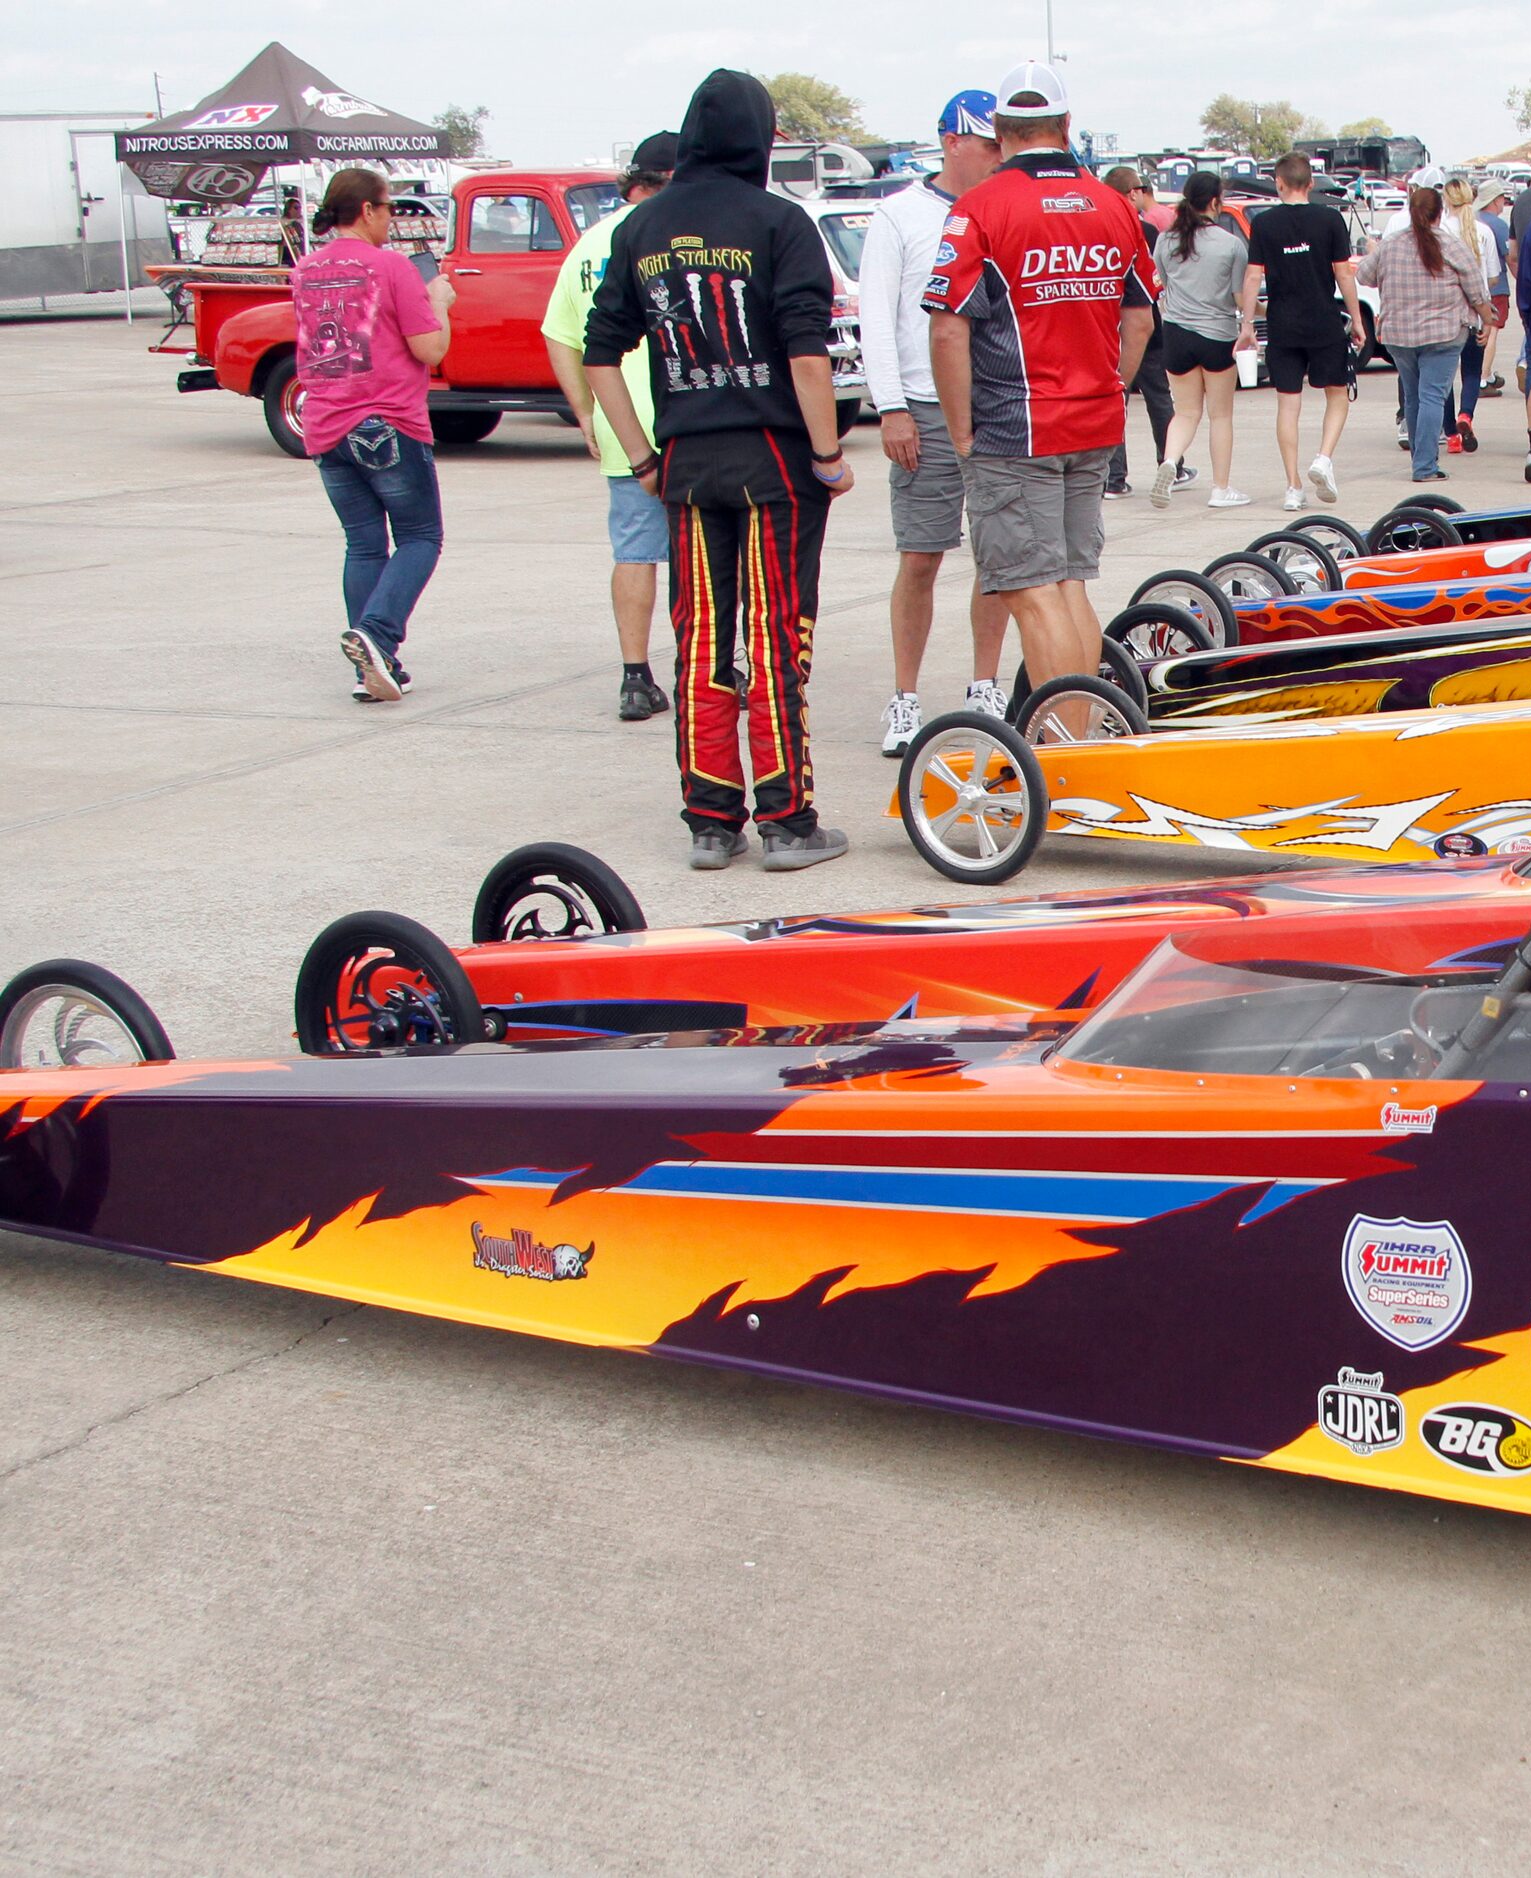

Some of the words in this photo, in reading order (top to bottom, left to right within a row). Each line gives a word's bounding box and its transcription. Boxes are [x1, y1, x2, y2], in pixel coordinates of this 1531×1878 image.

[126, 135, 289, 153] NITROUSEXPRESS.COM
[316, 135, 438, 151] OKCFARMTRUCK.COM
[638, 252, 672, 285] NIGHT
[675, 248, 752, 277] STALKERS
[1384, 1106, 1433, 1127] SUMMIT
[1382, 1242, 1437, 1255] IHRA
[1360, 1243, 1450, 1281] SUMMIT
[1368, 1286, 1449, 1308] SuperSeries
[1389, 1313, 1434, 1326] AMSOIL
[1341, 1369, 1381, 1387] SUMMIT
[1326, 1395, 1397, 1444] JDRL
[1438, 1417, 1502, 1458] BG
